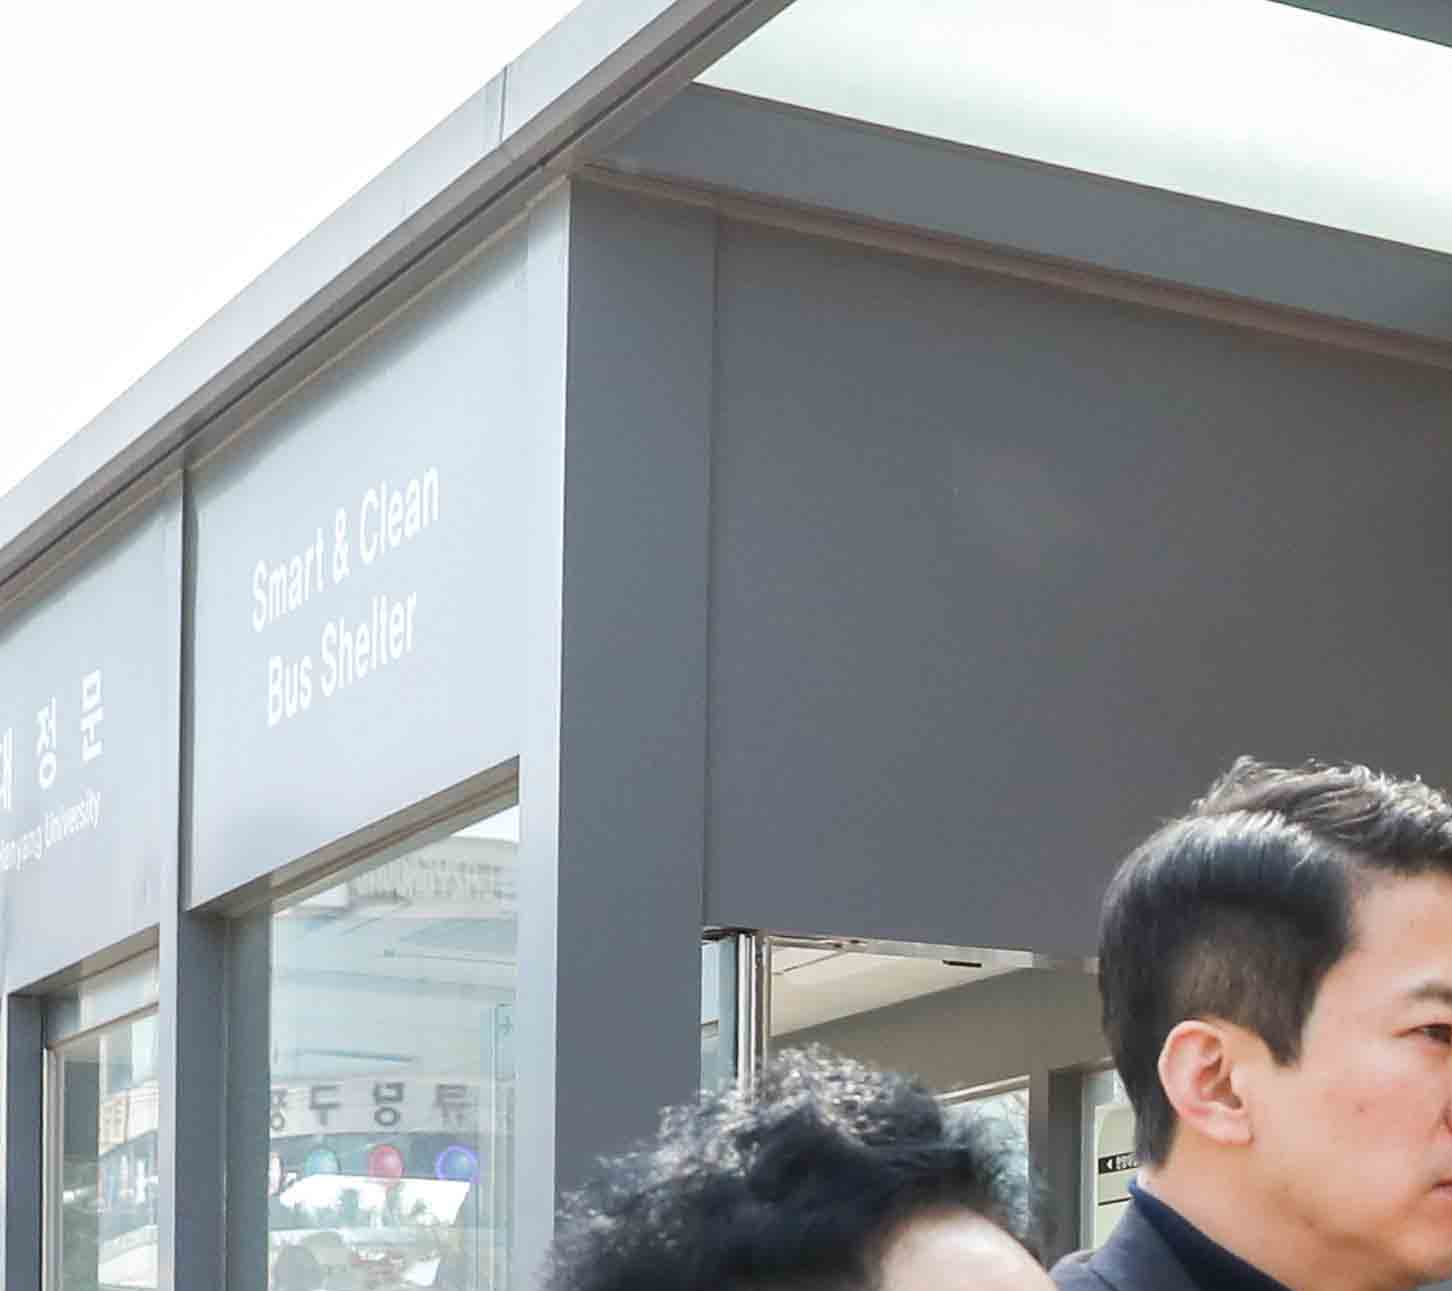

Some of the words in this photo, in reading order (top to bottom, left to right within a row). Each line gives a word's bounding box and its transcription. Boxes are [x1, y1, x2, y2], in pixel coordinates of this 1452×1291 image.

[252, 527, 324, 632] Smart
[333, 506, 350, 584] &
[359, 466, 440, 565] Clean
[267, 654, 313, 729] Bus
[320, 591, 418, 697] Shelter
